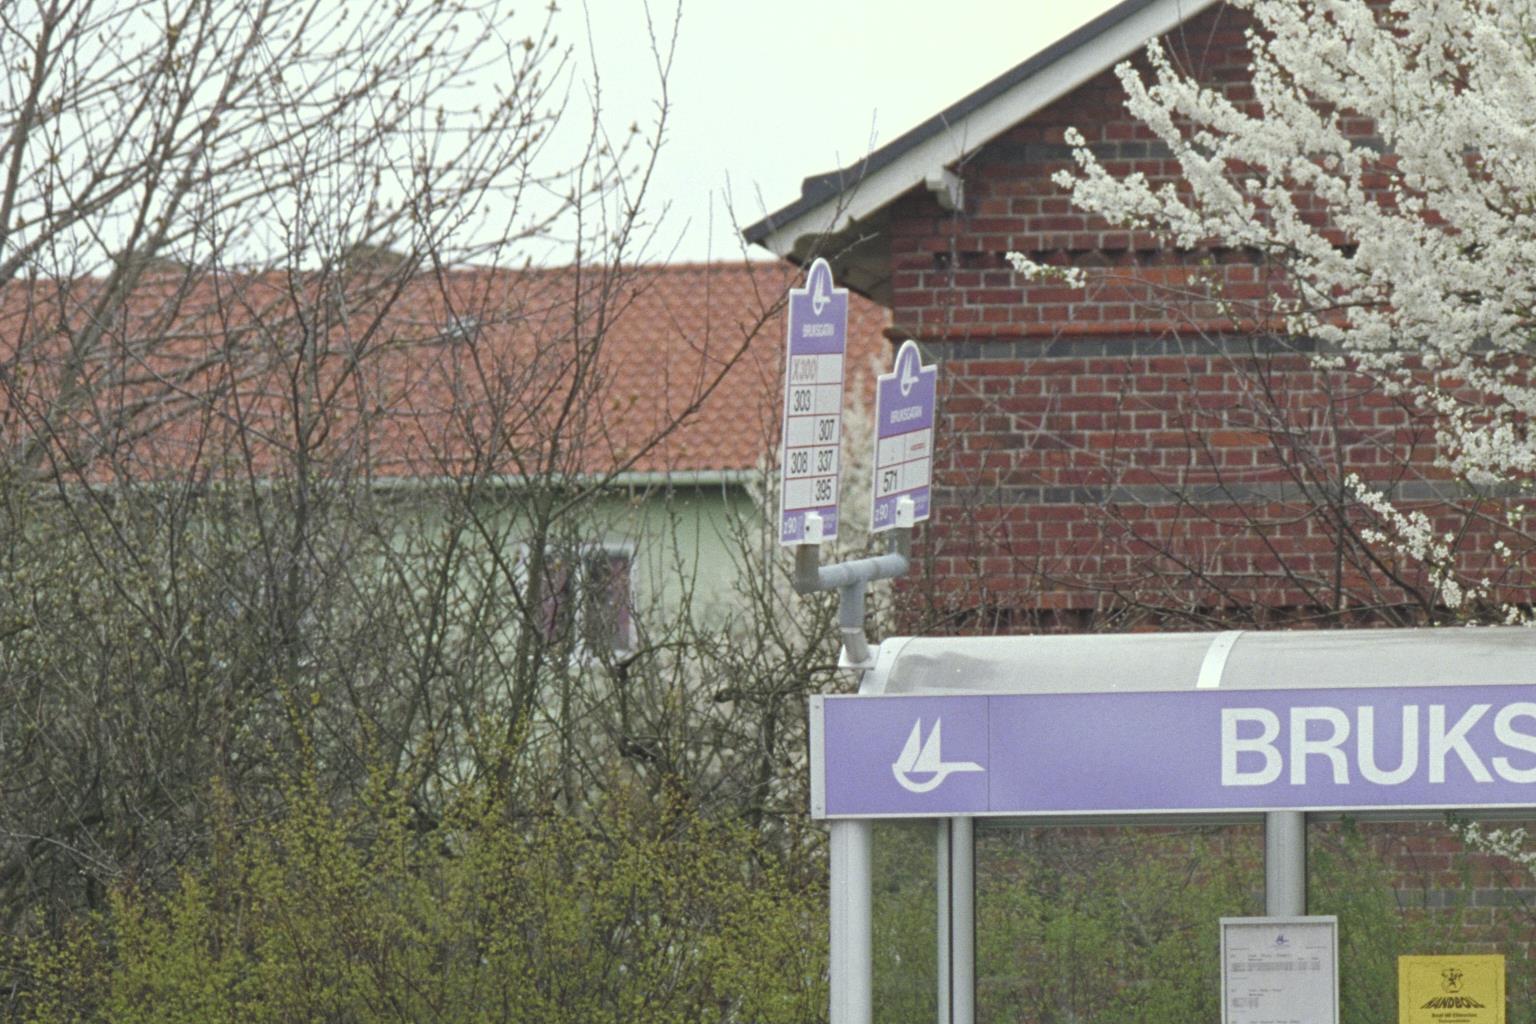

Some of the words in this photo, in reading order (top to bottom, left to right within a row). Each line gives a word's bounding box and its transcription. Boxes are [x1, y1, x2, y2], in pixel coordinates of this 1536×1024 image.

[794, 390, 811, 412] 303
[819, 419, 834, 441] 307
[791, 452, 808, 474] 308
[818, 450, 833, 472] 337
[815, 479, 832, 501] 395
[883, 470, 898, 493] 571
